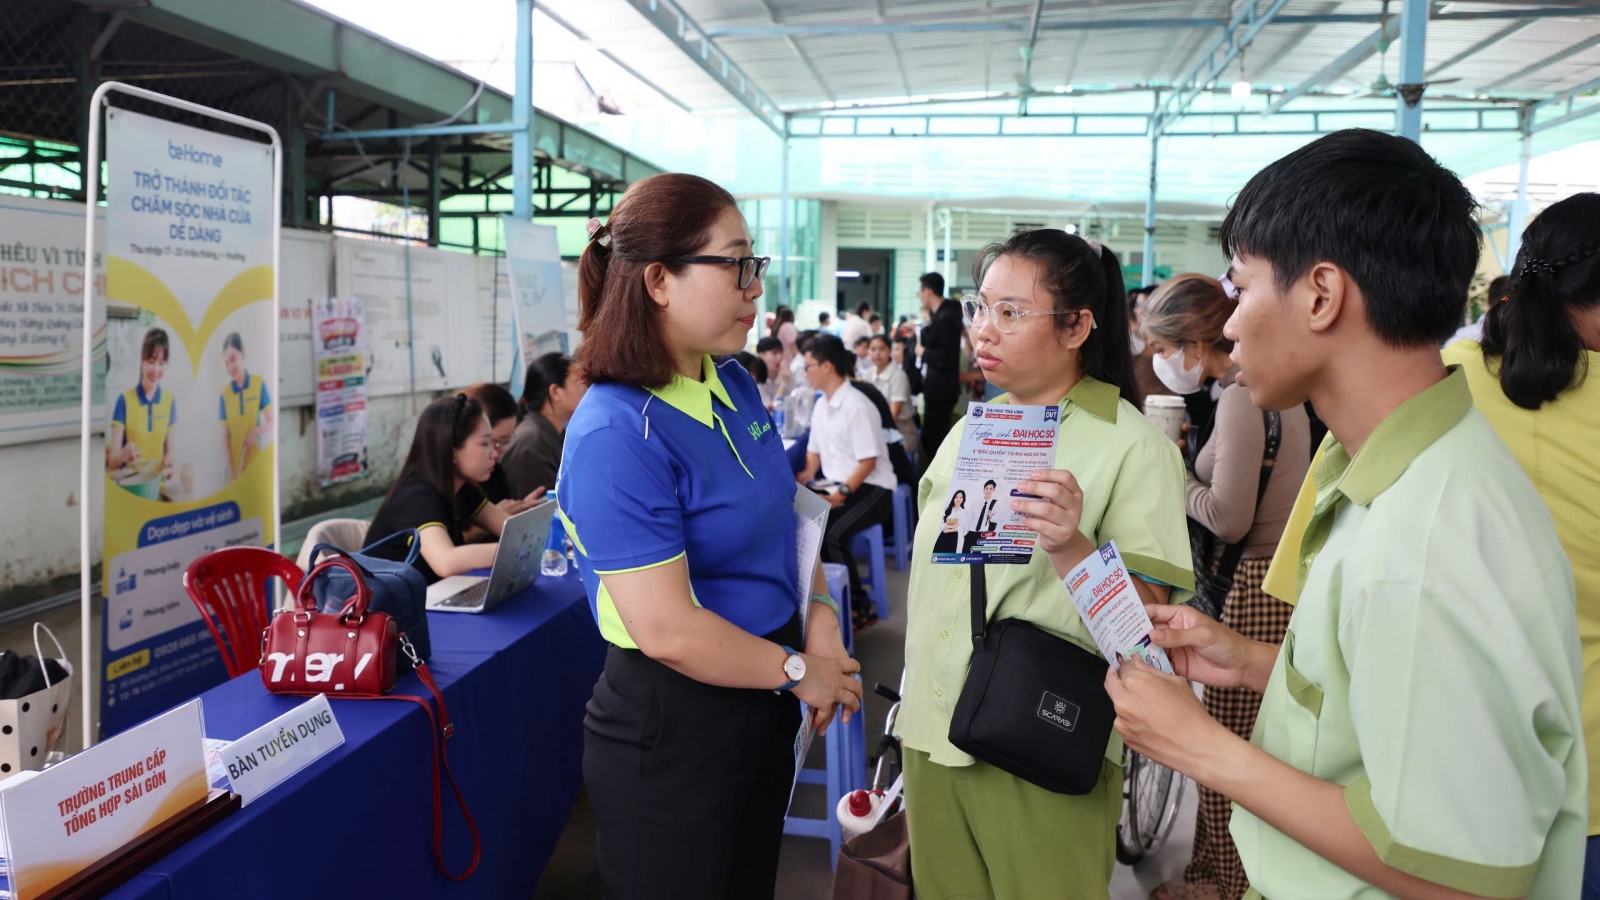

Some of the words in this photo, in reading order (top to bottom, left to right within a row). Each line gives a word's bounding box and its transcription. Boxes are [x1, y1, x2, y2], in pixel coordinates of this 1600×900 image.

[168, 140, 223, 167] beHome
[133, 169, 161, 190] TRỞ
[164, 175, 207, 196] THÀNH
[131, 196, 172, 215] CHĂM
[189, 224, 221, 243] DÀNG
[1013, 429, 1027, 440] ĐẠI
[1028, 430, 1047, 440] HỌC
[147, 526, 169, 543] Dọn
[1102, 574, 1115, 590] HỌC
[228, 752, 259, 780] BÀN
[257, 727, 299, 761] TUYỂN
[297, 710, 331, 739] DỤNG
[58, 781, 106, 817] TRƯỜNG
[108, 761, 144, 791] TRUNG
[146, 747, 166, 772] CẤP
[64, 808, 97, 836] TỔNG
[99, 794, 122, 818] HỢP
[124, 783, 143, 804] SÀI
[145, 770, 167, 793] GÒN
